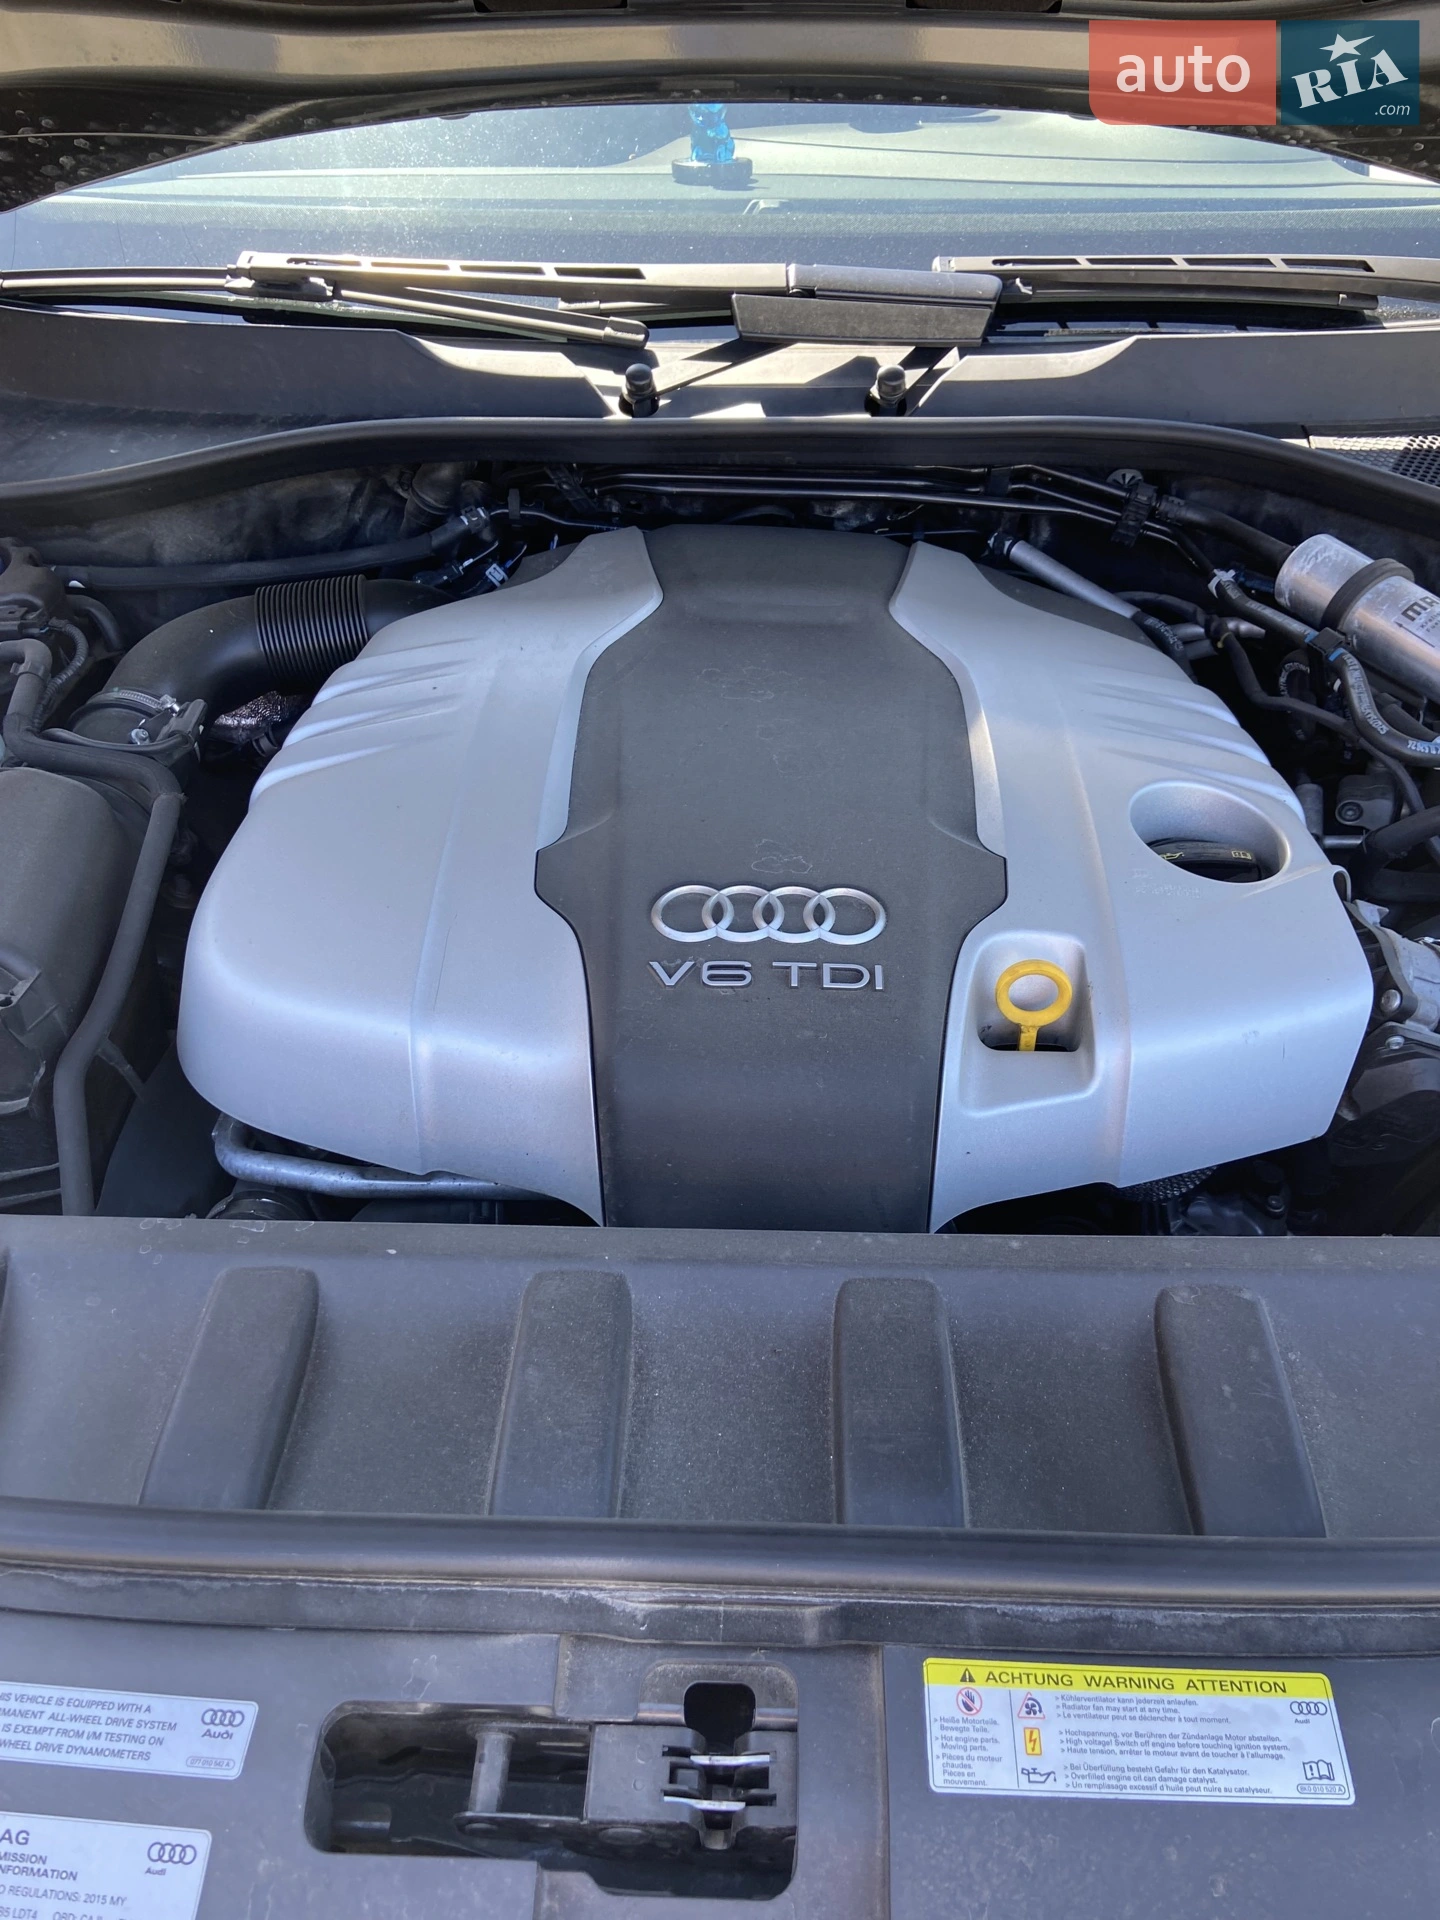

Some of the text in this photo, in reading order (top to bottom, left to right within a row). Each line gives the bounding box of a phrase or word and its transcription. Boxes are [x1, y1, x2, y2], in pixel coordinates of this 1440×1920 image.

[649, 960, 883, 990] V6 TDI
[985, 1671, 1287, 1694] ACHTUNG WARNING ATTENTION
[14, 1693, 54, 1706] VEHICLE
[54, 1697, 65, 1707] IS
[66, 1698, 115, 1711] EQUIPPED
[116, 1703, 143, 1713] WITH
[143, 1705, 152, 1713] A
[1061, 1694, 1199, 1706] Kühlerventilator kann jederzeit anlaufen.
[1062, 1703, 1091, 1711] Radiator
[1106, 1705, 1120, 1713] may
[1122, 1705, 1138, 1713] start
[0, 1708, 177, 1731] MANENT ALL-WHEEL DRIVE SYSTEM
[961, 1717, 1000, 1725] Motorteile.
[1063, 1711, 1071, 1719] Le
[1073, 1712, 1109, 1720] ventilateur
[1138, 1714, 1176, 1722] déclencher
[1, 1723, 165, 1746] IS EXEMPT FROM I/M TESTING ON
[201, 1728, 233, 1740] Audi
[940, 1724, 990, 1733] Bewegte Teile.
[941, 1734, 953, 1742] Hot
[955, 1736, 979, 1744] engine
[1065, 1728, 1120, 1738] Hochspannung,
[1134, 1731, 1167, 1739] Berühren
[1182, 1732, 1223, 1741] Zündanlage
[1248, 1734, 1282, 1742] abstellen.
[34, 1741, 64, 1754] DRIVE
[65, 1744, 151, 1761] DYNAMOMETERS
[941, 1742, 968, 1752] Moving
[1066, 1738, 1082, 1747] High
[1084, 1739, 1112, 1747] voltage!
[1114, 1739, 1138, 1747] Switch
[1151, 1741, 1176, 1749] engine
[1177, 1741, 1200, 1749] before
[1201, 1742, 1232, 1751] touching
[1234, 1743, 1261, 1751] ignition
[1262, 1744, 1291, 1752] system.
[942, 1753, 964, 1761] Pièces
[1089, 1747, 1117, 1756] tension,
[1119, 1748, 1142, 1756] arrêter
[1201, 1750, 1210, 1758] de
[942, 1761, 973, 1769] chaudes.
[1070, 1763, 1081, 1771] Bei
[1083, 1762, 1125, 1773] Überfüllung
[1126, 1765, 1153, 1773] besteht
[1154, 1765, 1178, 1774] Gefahr
[1180, 1766, 1191, 1774] für
[1208, 1768, 1250, 1776] Katalysator.
[943, 1769, 965, 1777] Pièces
[1070, 1772, 1105, 1780] Overfilled
[1107, 1774, 1131, 1782] engine
[1158, 1776, 1187, 1784] damage
[1188, 1777, 1218, 1785] catalyst.
[1071, 1781, 1082, 1789] Un
[1084, 1782, 1127, 1791] remplissage
[0, 1828, 30, 1846] AG
[145, 1867, 167, 1876] Audi
[8, 1885, 81, 1902] REGULATIONS:
[83, 1893, 107, 1905] 2015
[109, 1896, 128, 1906] MY
[12, 1908, 38, 1919] LDT4
